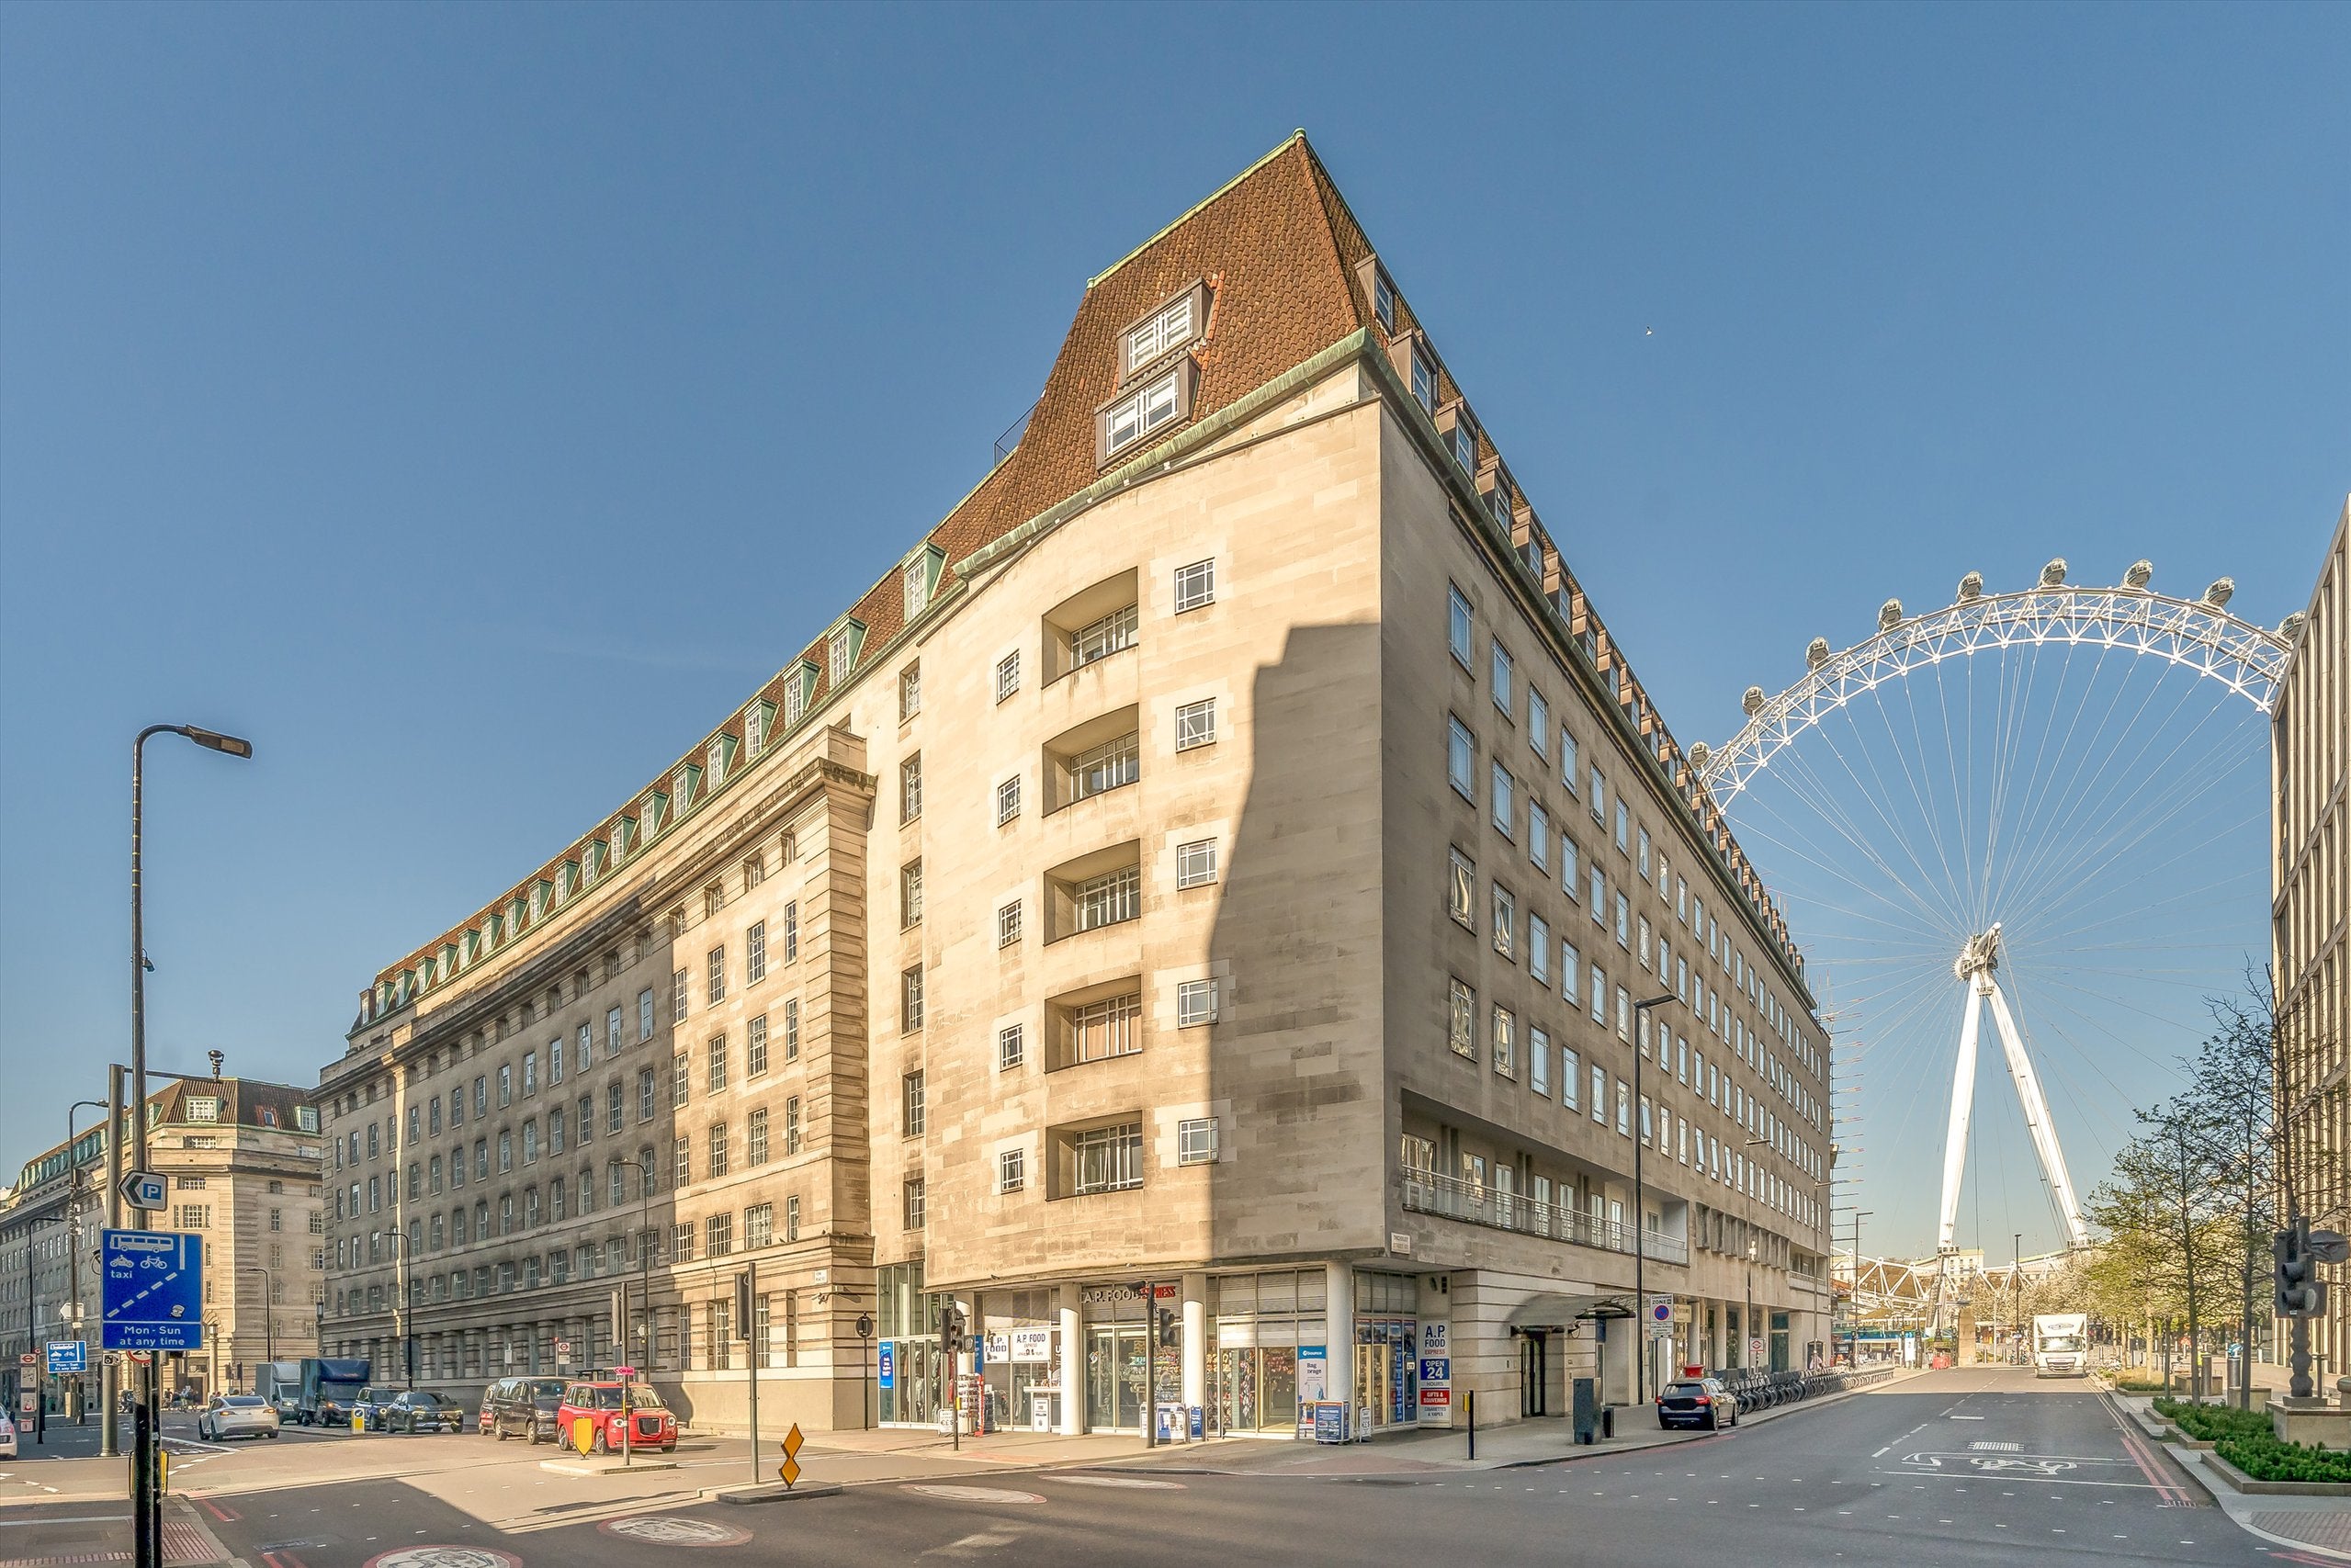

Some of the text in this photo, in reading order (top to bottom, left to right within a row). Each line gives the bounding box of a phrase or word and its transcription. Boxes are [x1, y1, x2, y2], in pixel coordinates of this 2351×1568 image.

[148, 1186, 159, 1198] P
[110, 1269, 133, 1279] taxi
[124, 1326, 150, 1335] Mon
[1426, 1325, 1445, 1337] A.P.
[136, 1339, 156, 1348] any
[160, 1337, 185, 1346] time
[1029, 1333, 1046, 1343] FOOD
[1425, 1339, 1445, 1348] FOOD
[1427, 1367, 1444, 1380] 24
